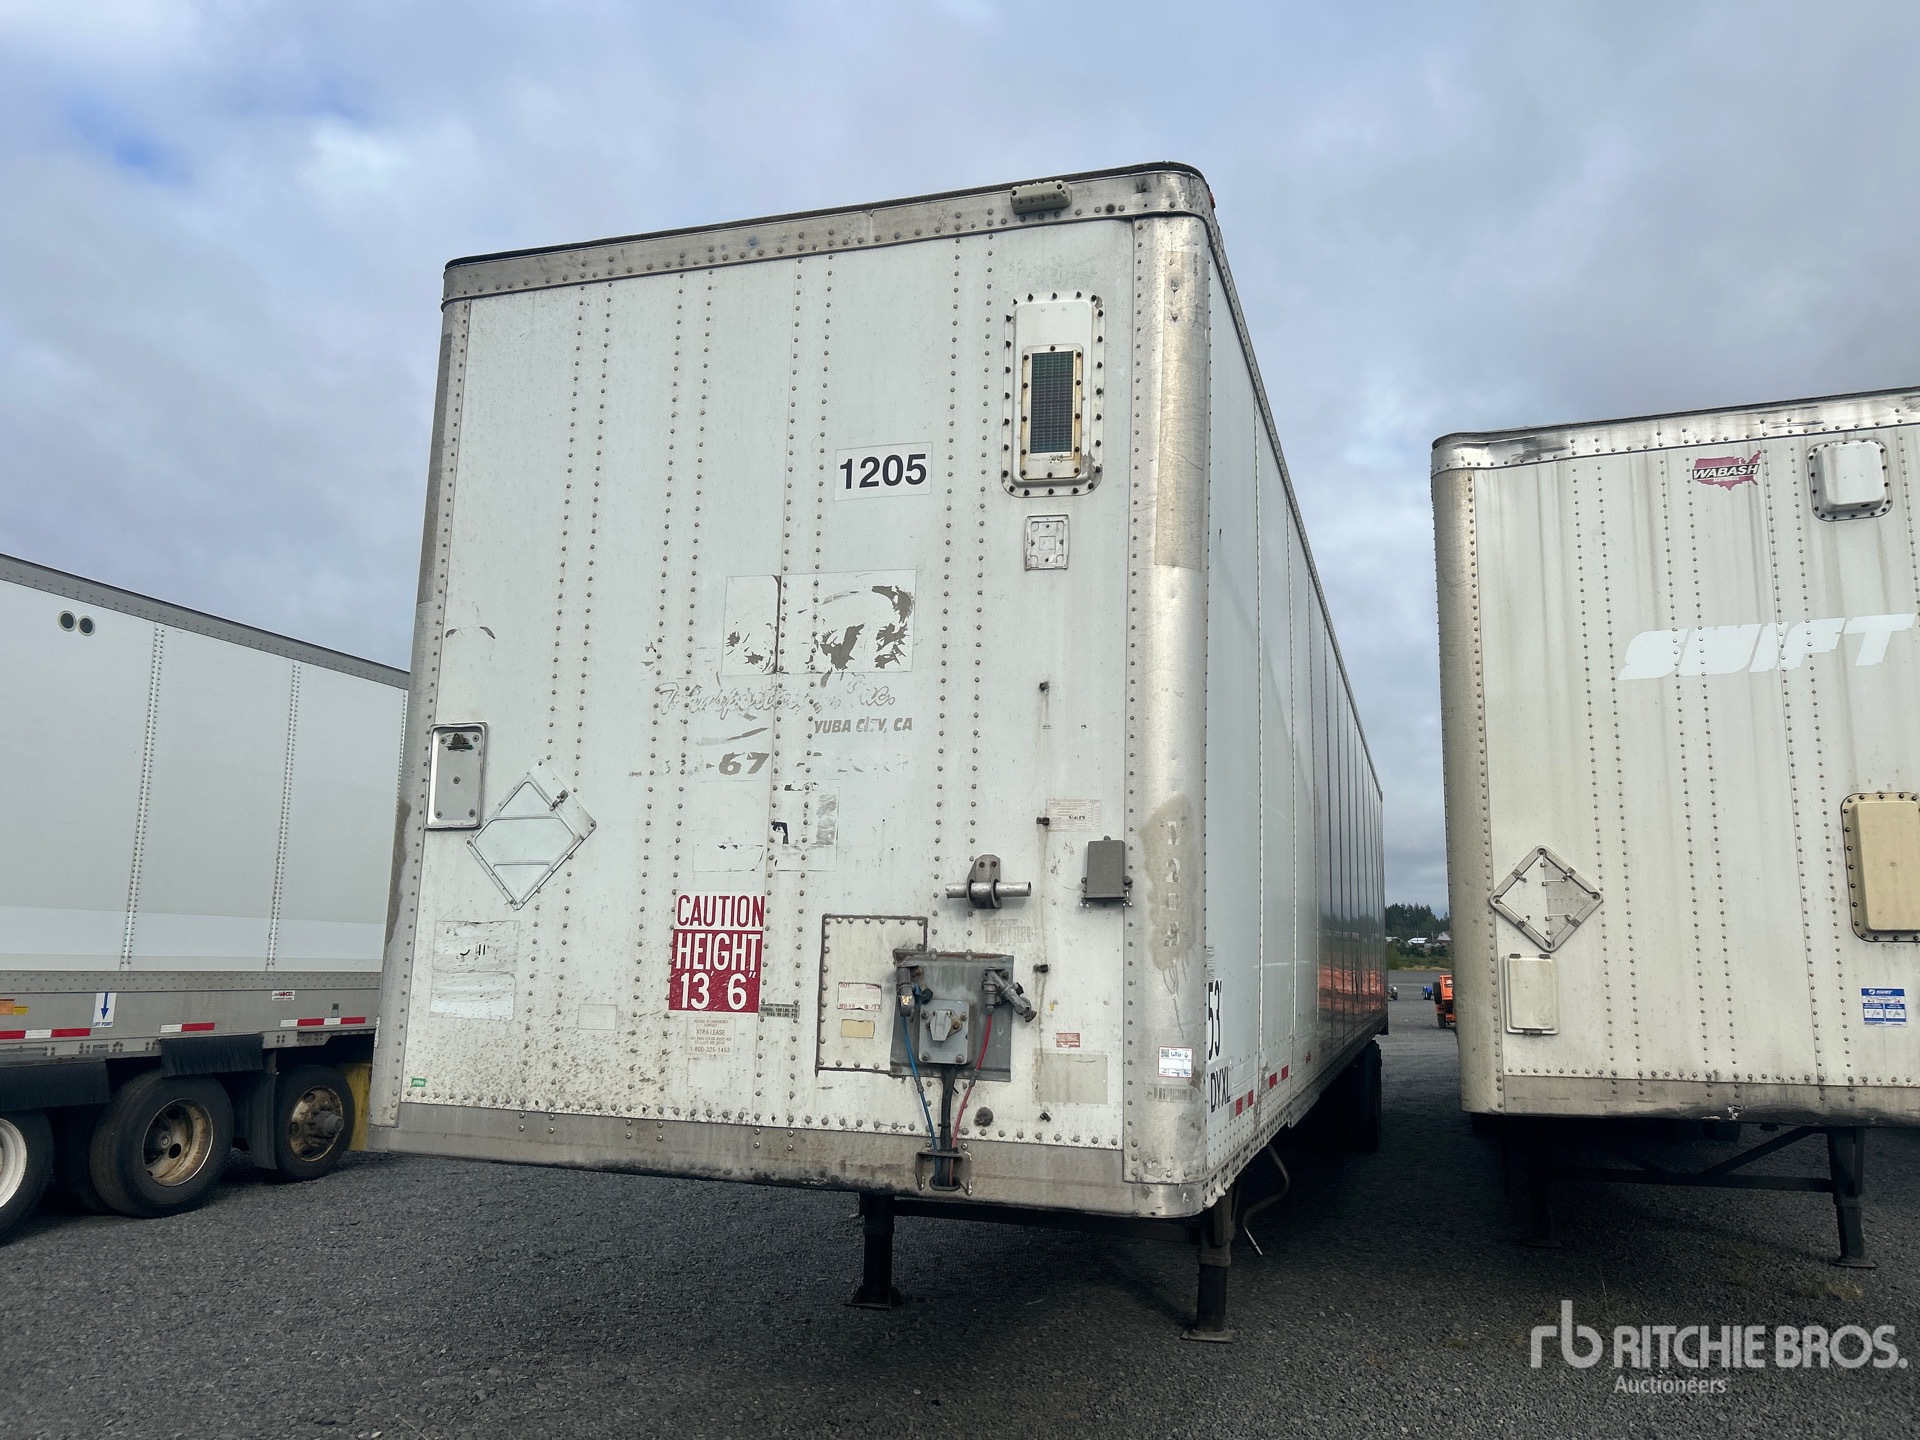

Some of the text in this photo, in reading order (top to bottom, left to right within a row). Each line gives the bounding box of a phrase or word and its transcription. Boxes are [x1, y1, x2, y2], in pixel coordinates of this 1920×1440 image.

[839, 453, 927, 490] 1205
[1693, 463, 1759, 479] WABASH
[1618, 613, 1916, 681] SWIFT
[814, 719, 852, 734] YUBA
[893, 717, 913, 732] CA
[676, 894, 766, 928] CAUTION
[675, 932, 761, 971] HEIGHT
[1210, 1065, 1231, 1114] DYXL
